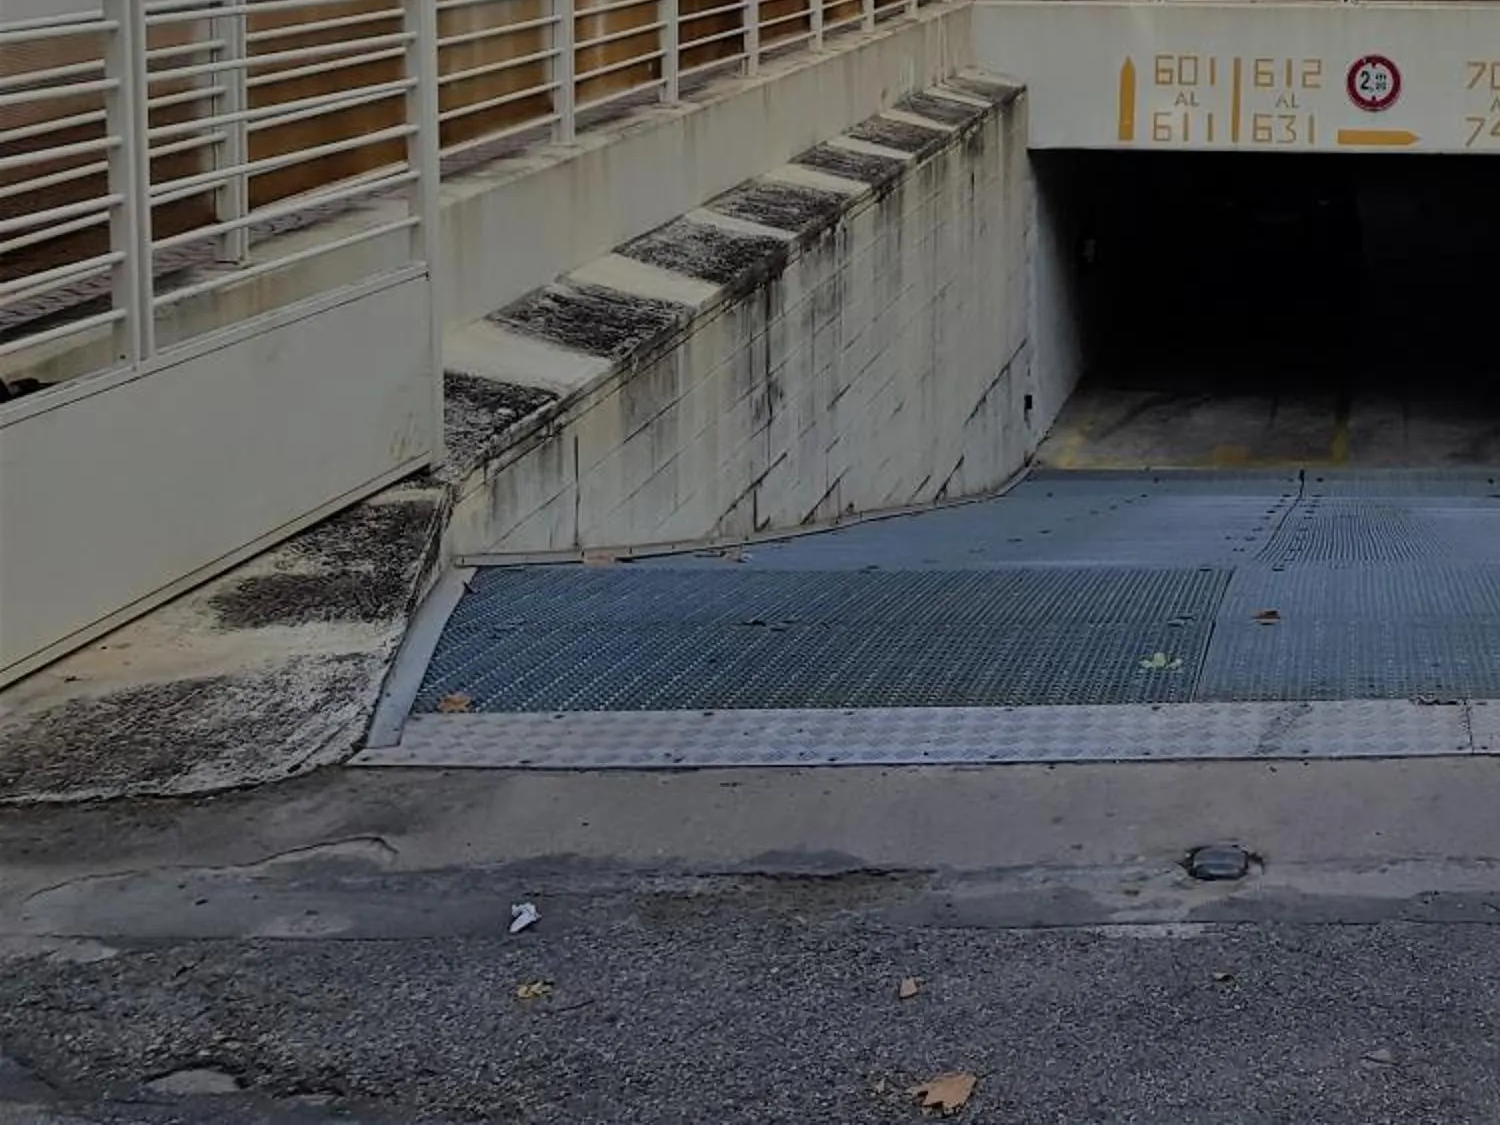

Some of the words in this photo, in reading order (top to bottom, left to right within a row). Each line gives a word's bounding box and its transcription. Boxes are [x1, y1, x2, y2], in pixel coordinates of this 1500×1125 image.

[1154, 55, 1217, 87] 601
[1253, 57, 1322, 89] 612
[1174, 91, 1200, 108] AL
[1275, 91, 1301, 108] AL
[1152, 112, 1214, 143] 611
[1252, 113, 1315, 145] 631
